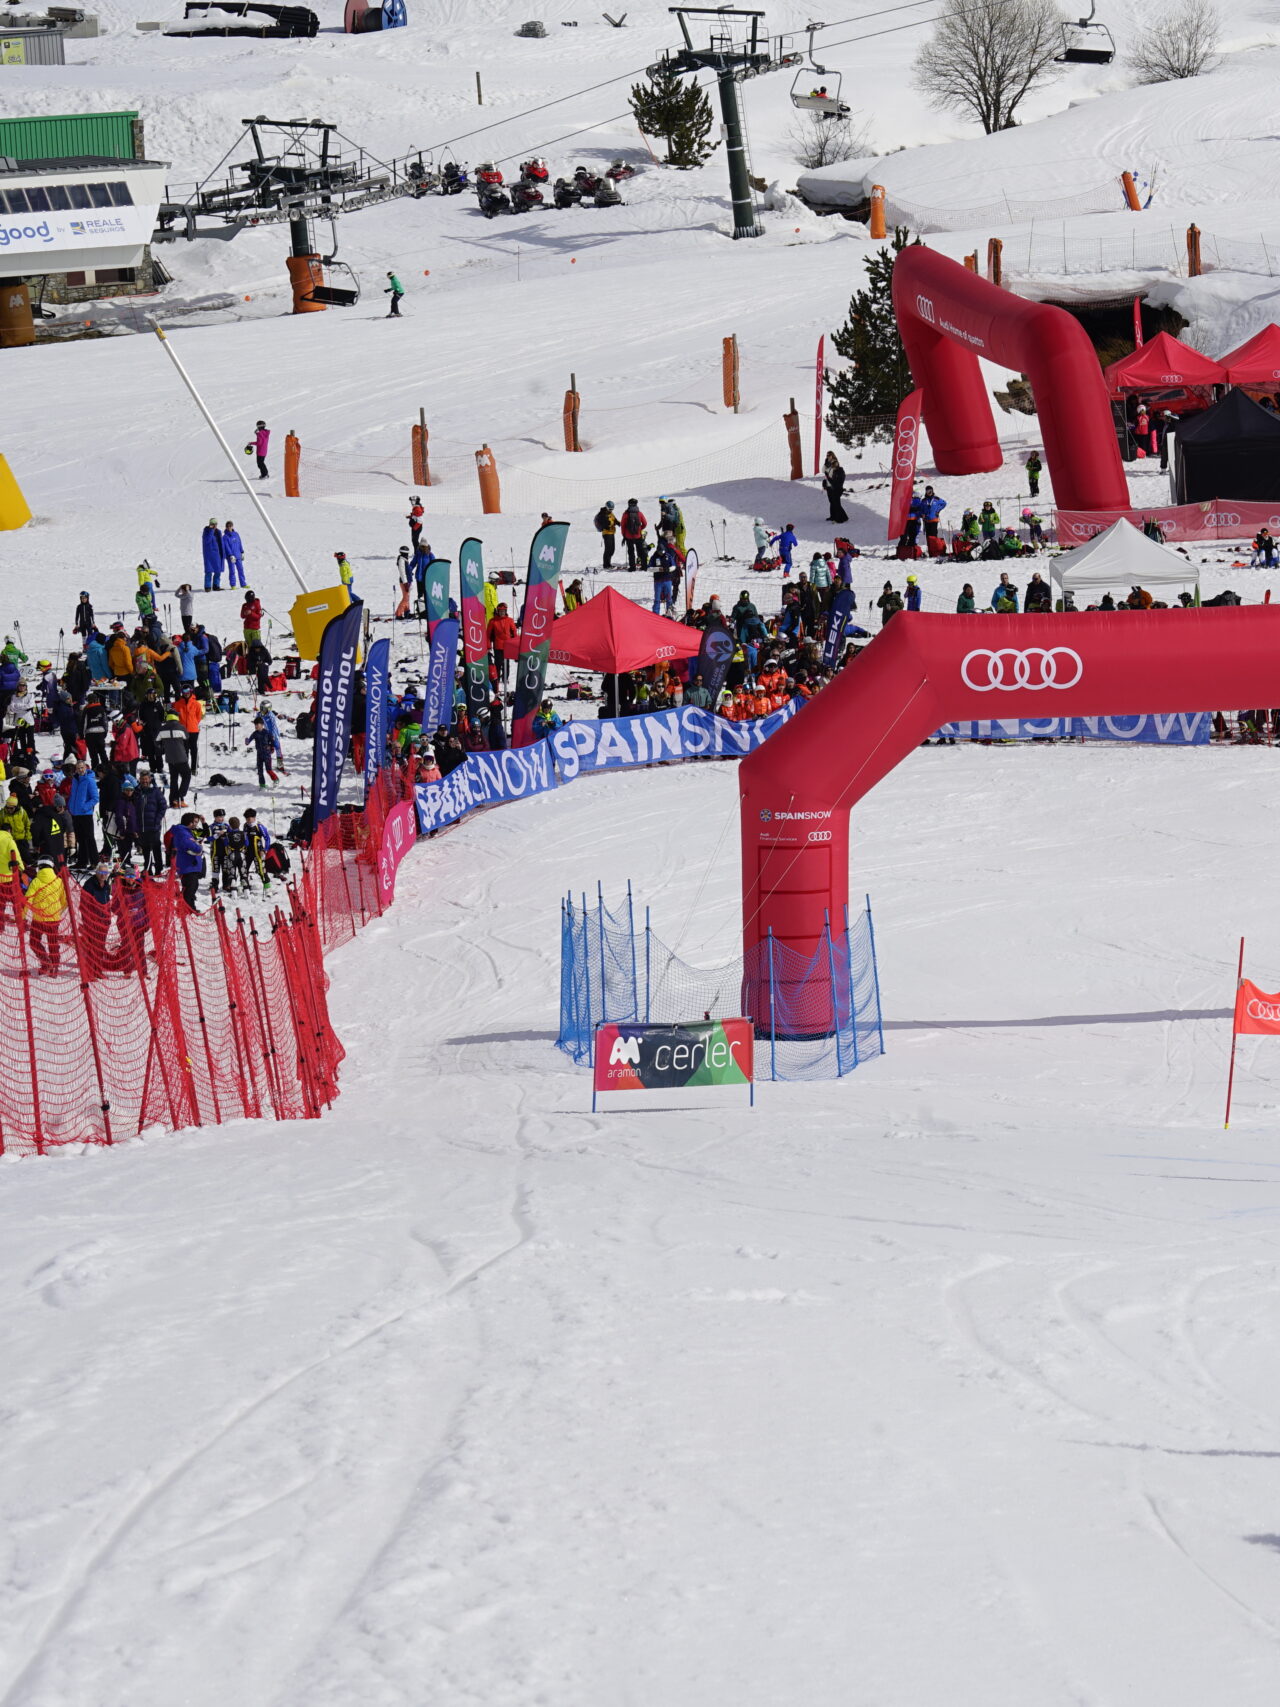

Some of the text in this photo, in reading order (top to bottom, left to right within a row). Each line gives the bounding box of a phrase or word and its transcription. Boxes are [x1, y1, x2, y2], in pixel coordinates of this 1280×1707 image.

[86, 218, 123, 228] REALE
[89, 226, 125, 234] SEGUROS
[524, 596, 550, 690] cerler
[825, 610, 843, 658] LEKI
[466, 610, 485, 702] cerler
[415, 740, 549, 829] SPAINSNOW
[774, 810, 832, 820] SPAINSNOW
[655, 1034, 742, 1071] cerler
[607, 1067, 642, 1078] aramon
